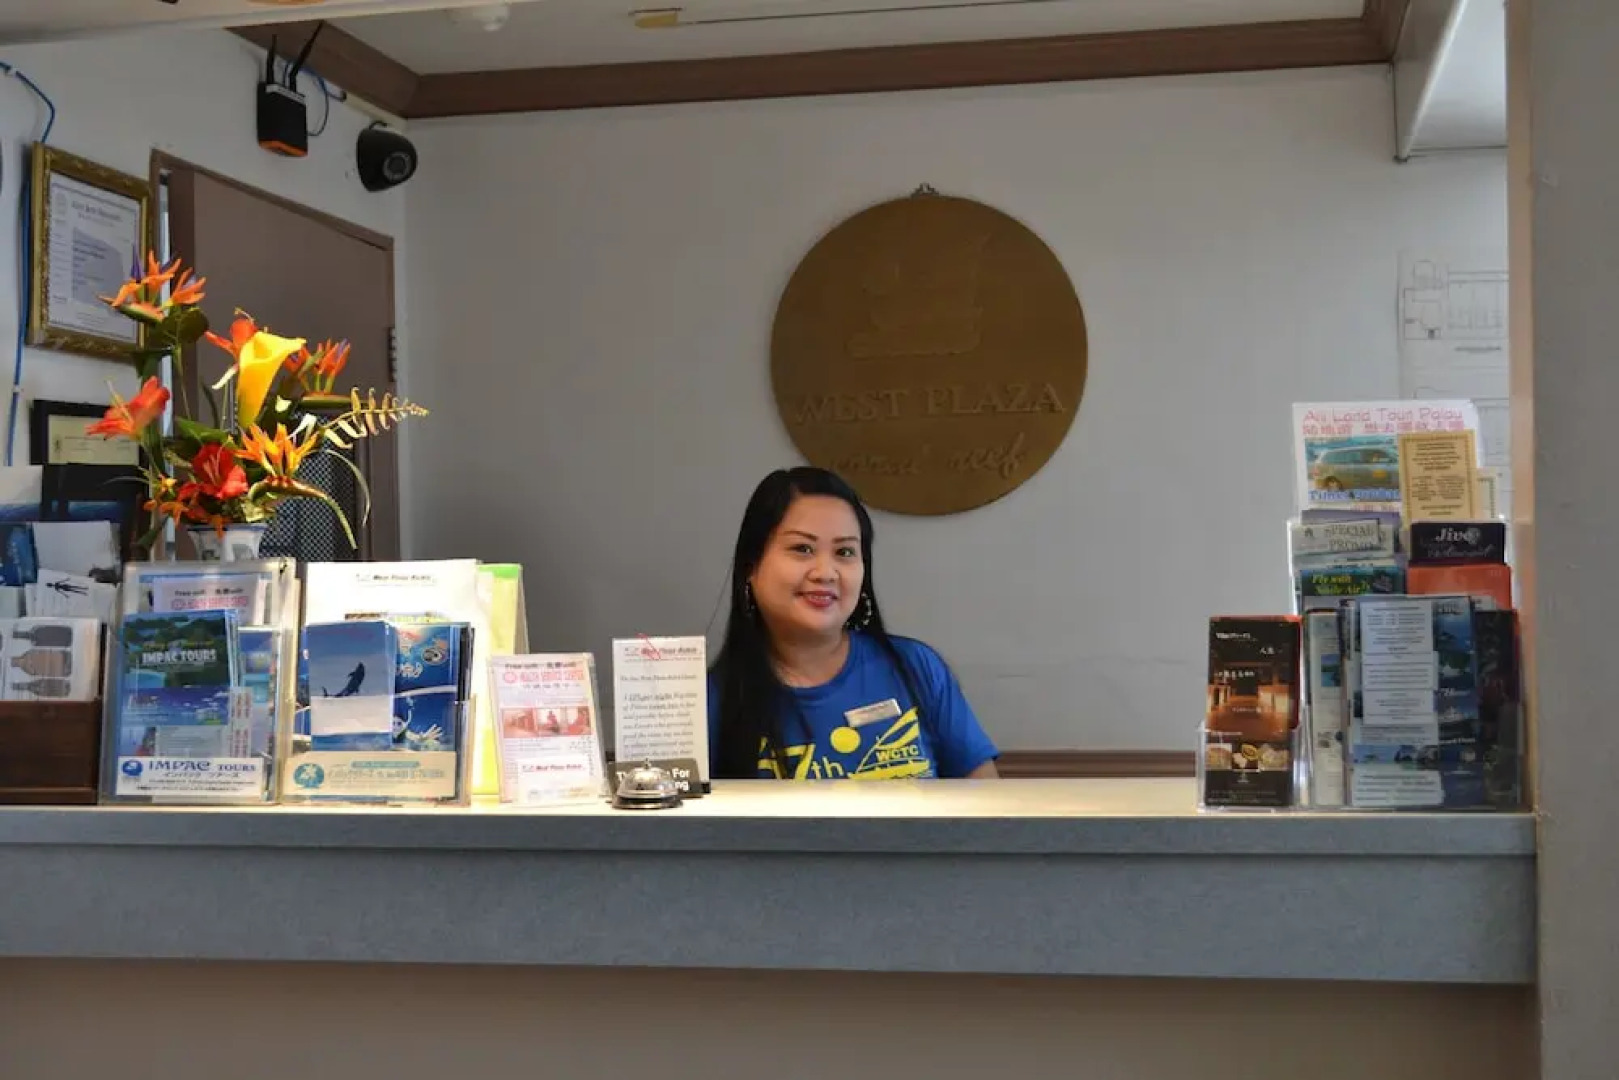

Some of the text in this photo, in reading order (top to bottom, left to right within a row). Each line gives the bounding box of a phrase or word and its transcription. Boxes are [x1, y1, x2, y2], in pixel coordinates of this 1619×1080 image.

[795, 382, 1067, 424] WEST PLAZA
[1333, 407, 1371, 422] Land
[1379, 407, 1413, 421] Tour
[1419, 406, 1463, 420] Palau
[142, 648, 216, 665] IMPAC TOURS
[876, 744, 919, 762] WCTC
[148, 760, 257, 772] IMPAC TOURS
[672, 767, 691, 779] For
